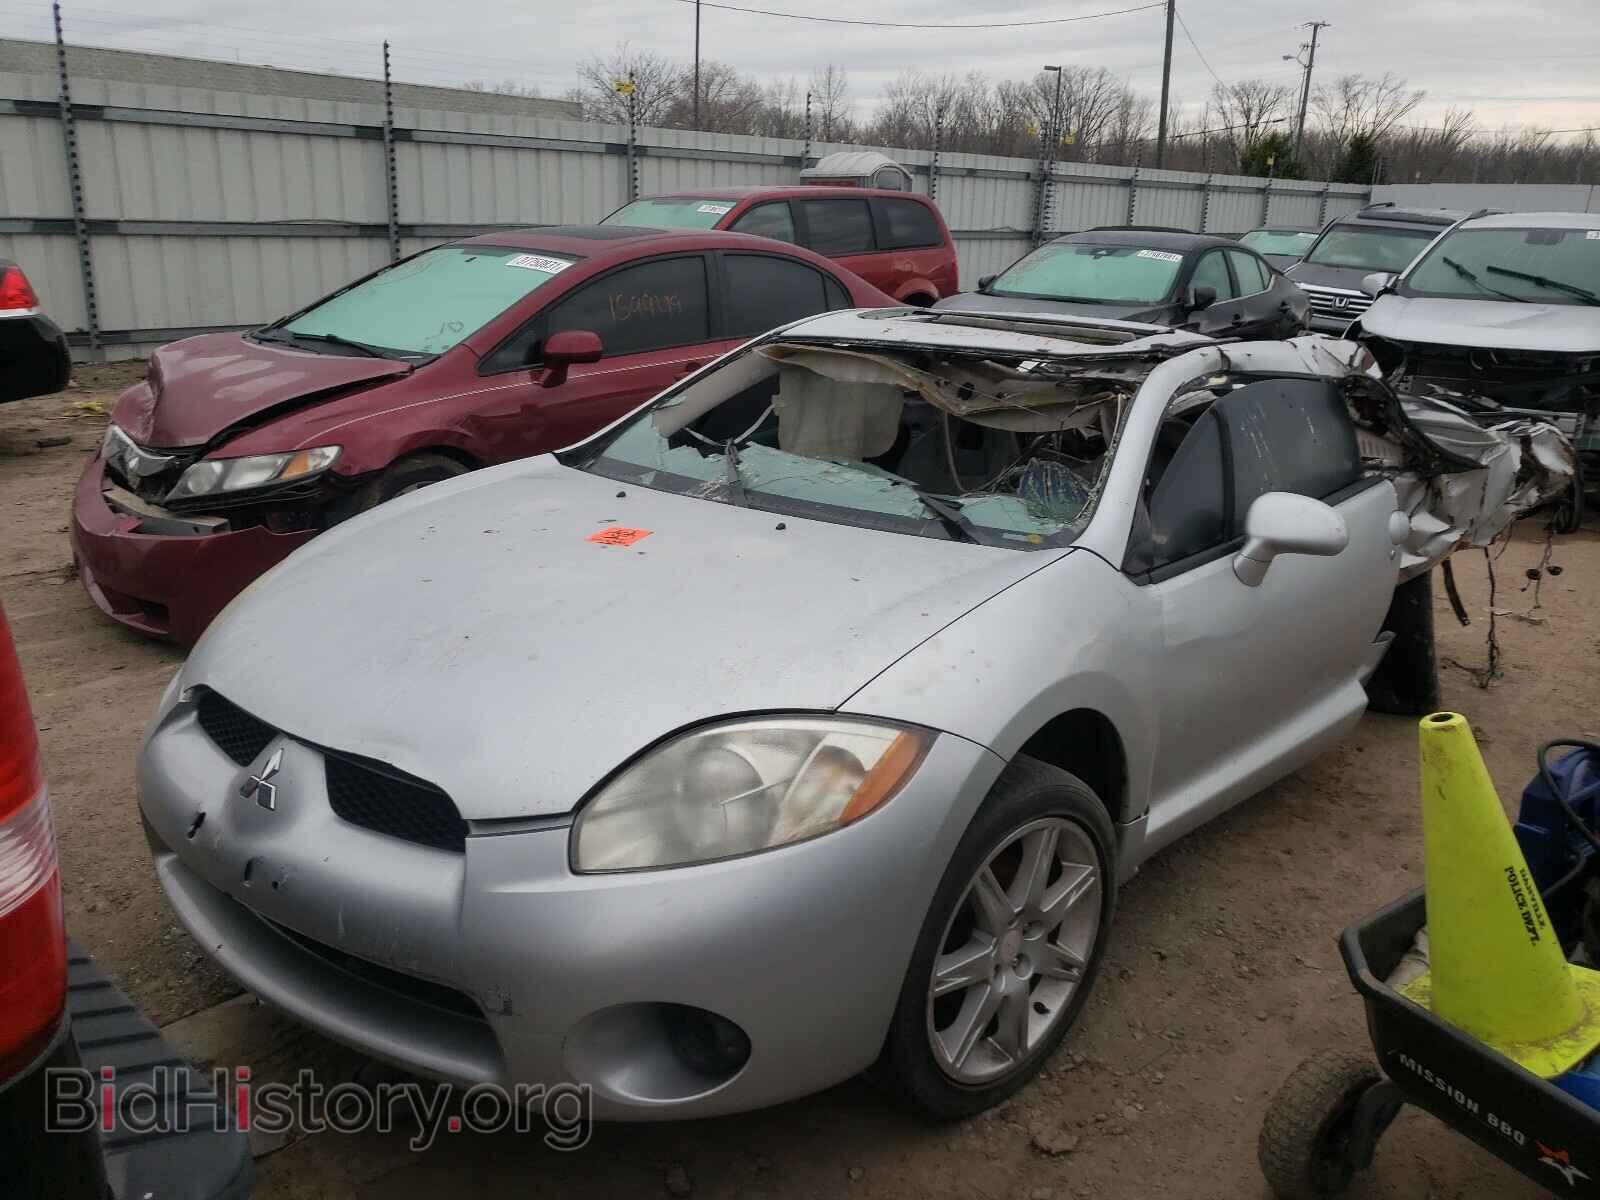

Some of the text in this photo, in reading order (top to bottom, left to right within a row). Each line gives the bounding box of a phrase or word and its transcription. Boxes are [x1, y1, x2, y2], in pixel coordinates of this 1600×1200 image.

[1504, 866, 1528, 911] POLICE
[1400, 1053, 1526, 1147] MISSION BBQ
